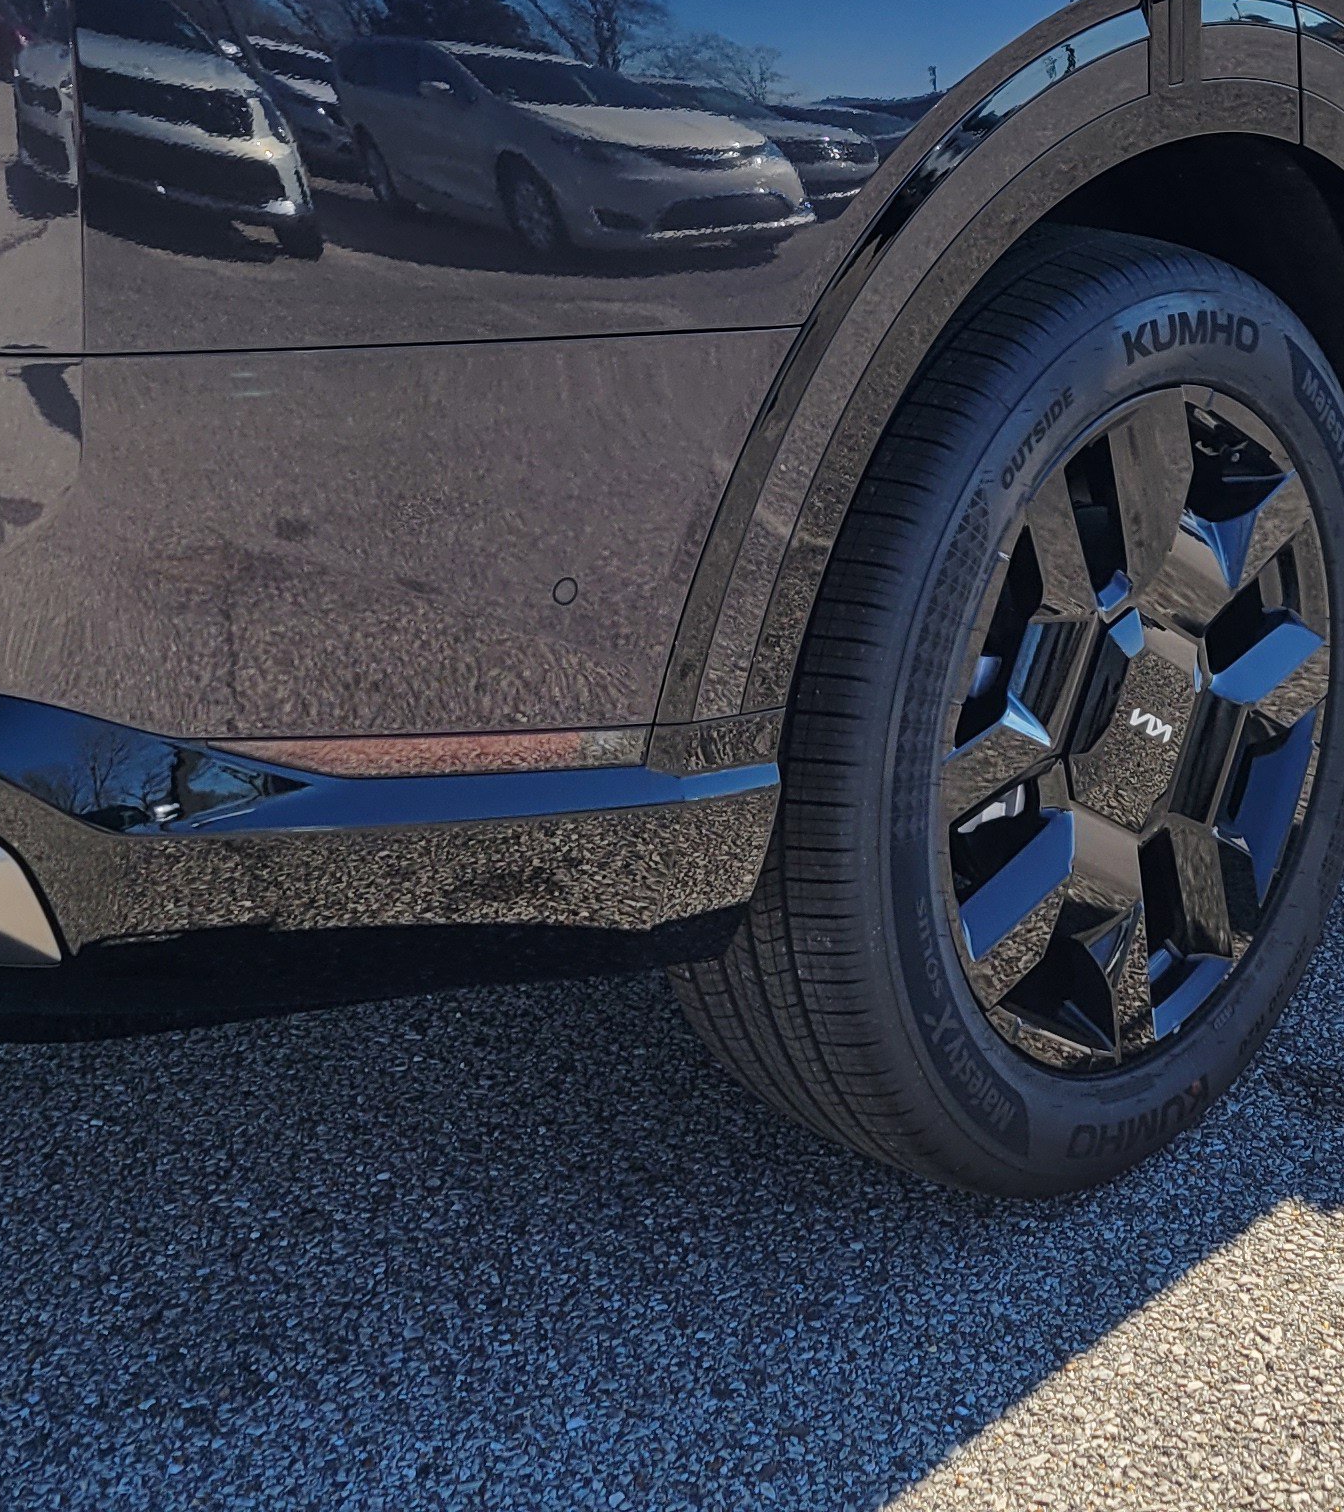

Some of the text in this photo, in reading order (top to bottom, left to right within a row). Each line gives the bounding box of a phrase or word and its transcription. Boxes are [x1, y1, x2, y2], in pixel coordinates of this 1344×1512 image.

[1122, 311, 1259, 366] KUMHO
[1001, 386, 1075, 491] OUTSIDE
[1129, 707, 1173, 744] KIA
